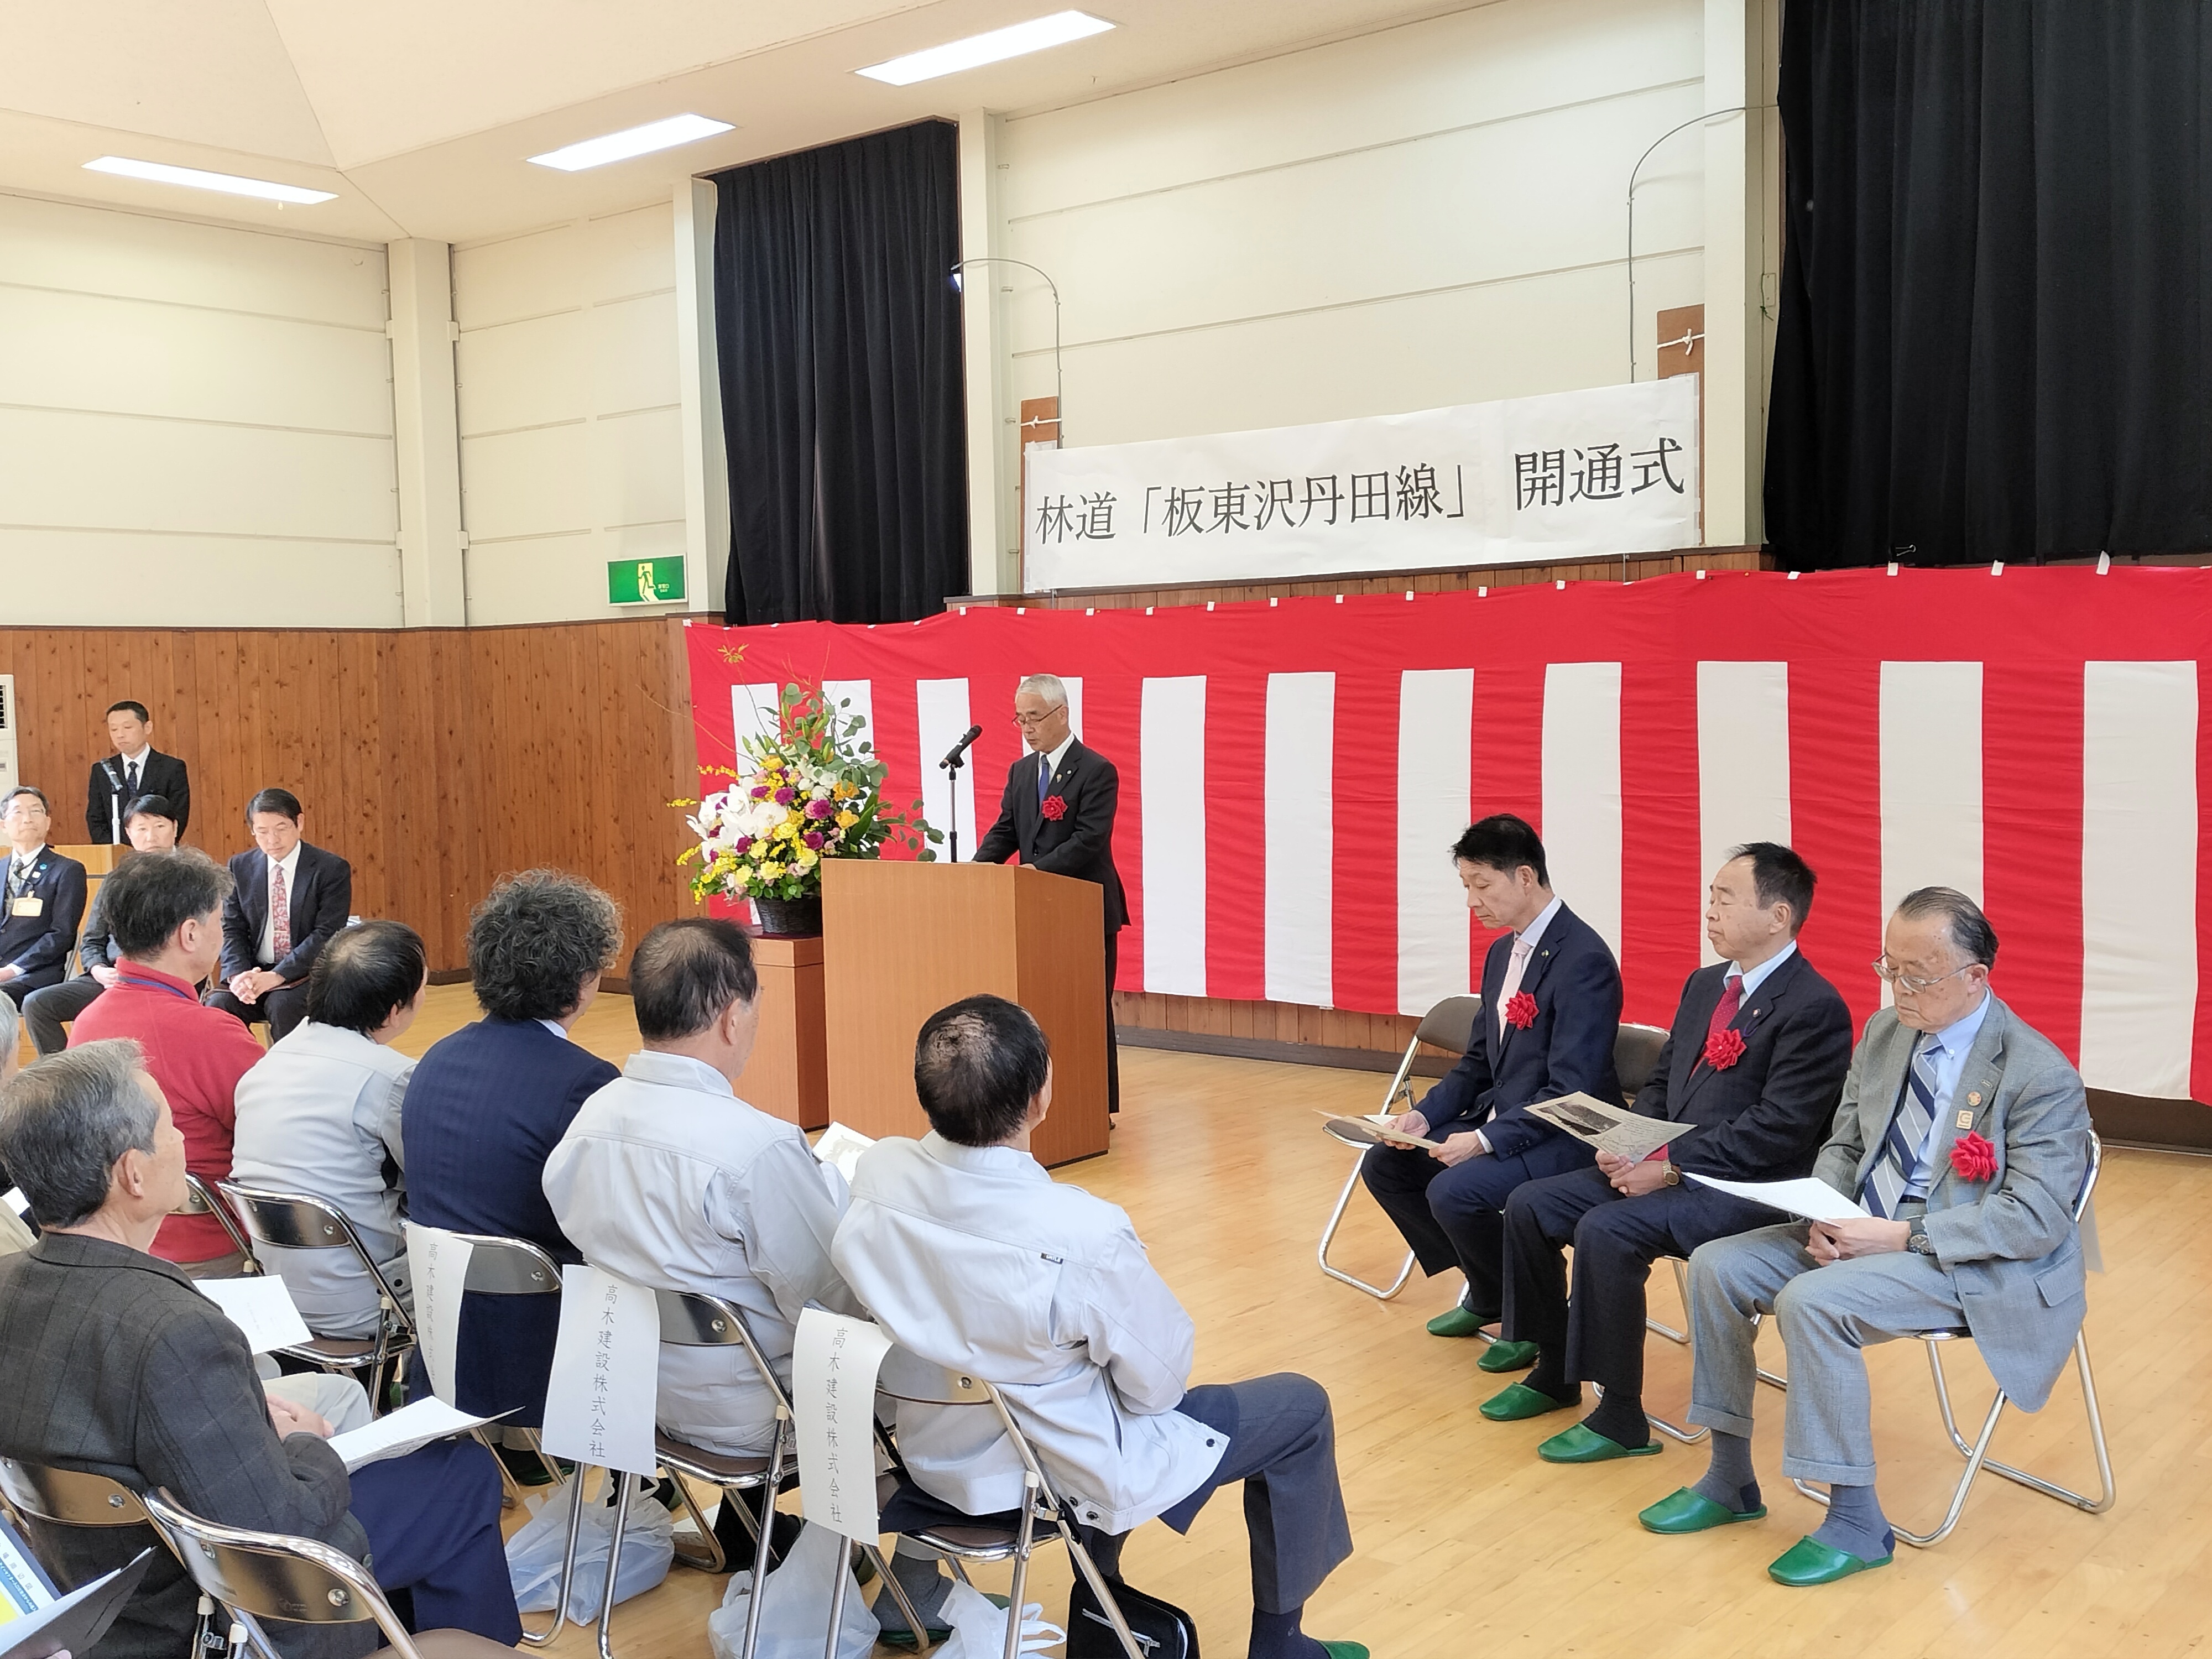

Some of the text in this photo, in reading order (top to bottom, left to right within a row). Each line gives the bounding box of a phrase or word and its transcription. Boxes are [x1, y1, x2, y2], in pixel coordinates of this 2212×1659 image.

[1035, 437, 1686, 545] 林道「板東沢丹田線」 開通式
[588, 1284, 618, 1458] 高木建設株式会社
[826, 1327, 848, 1523] 高木建設株式会社
